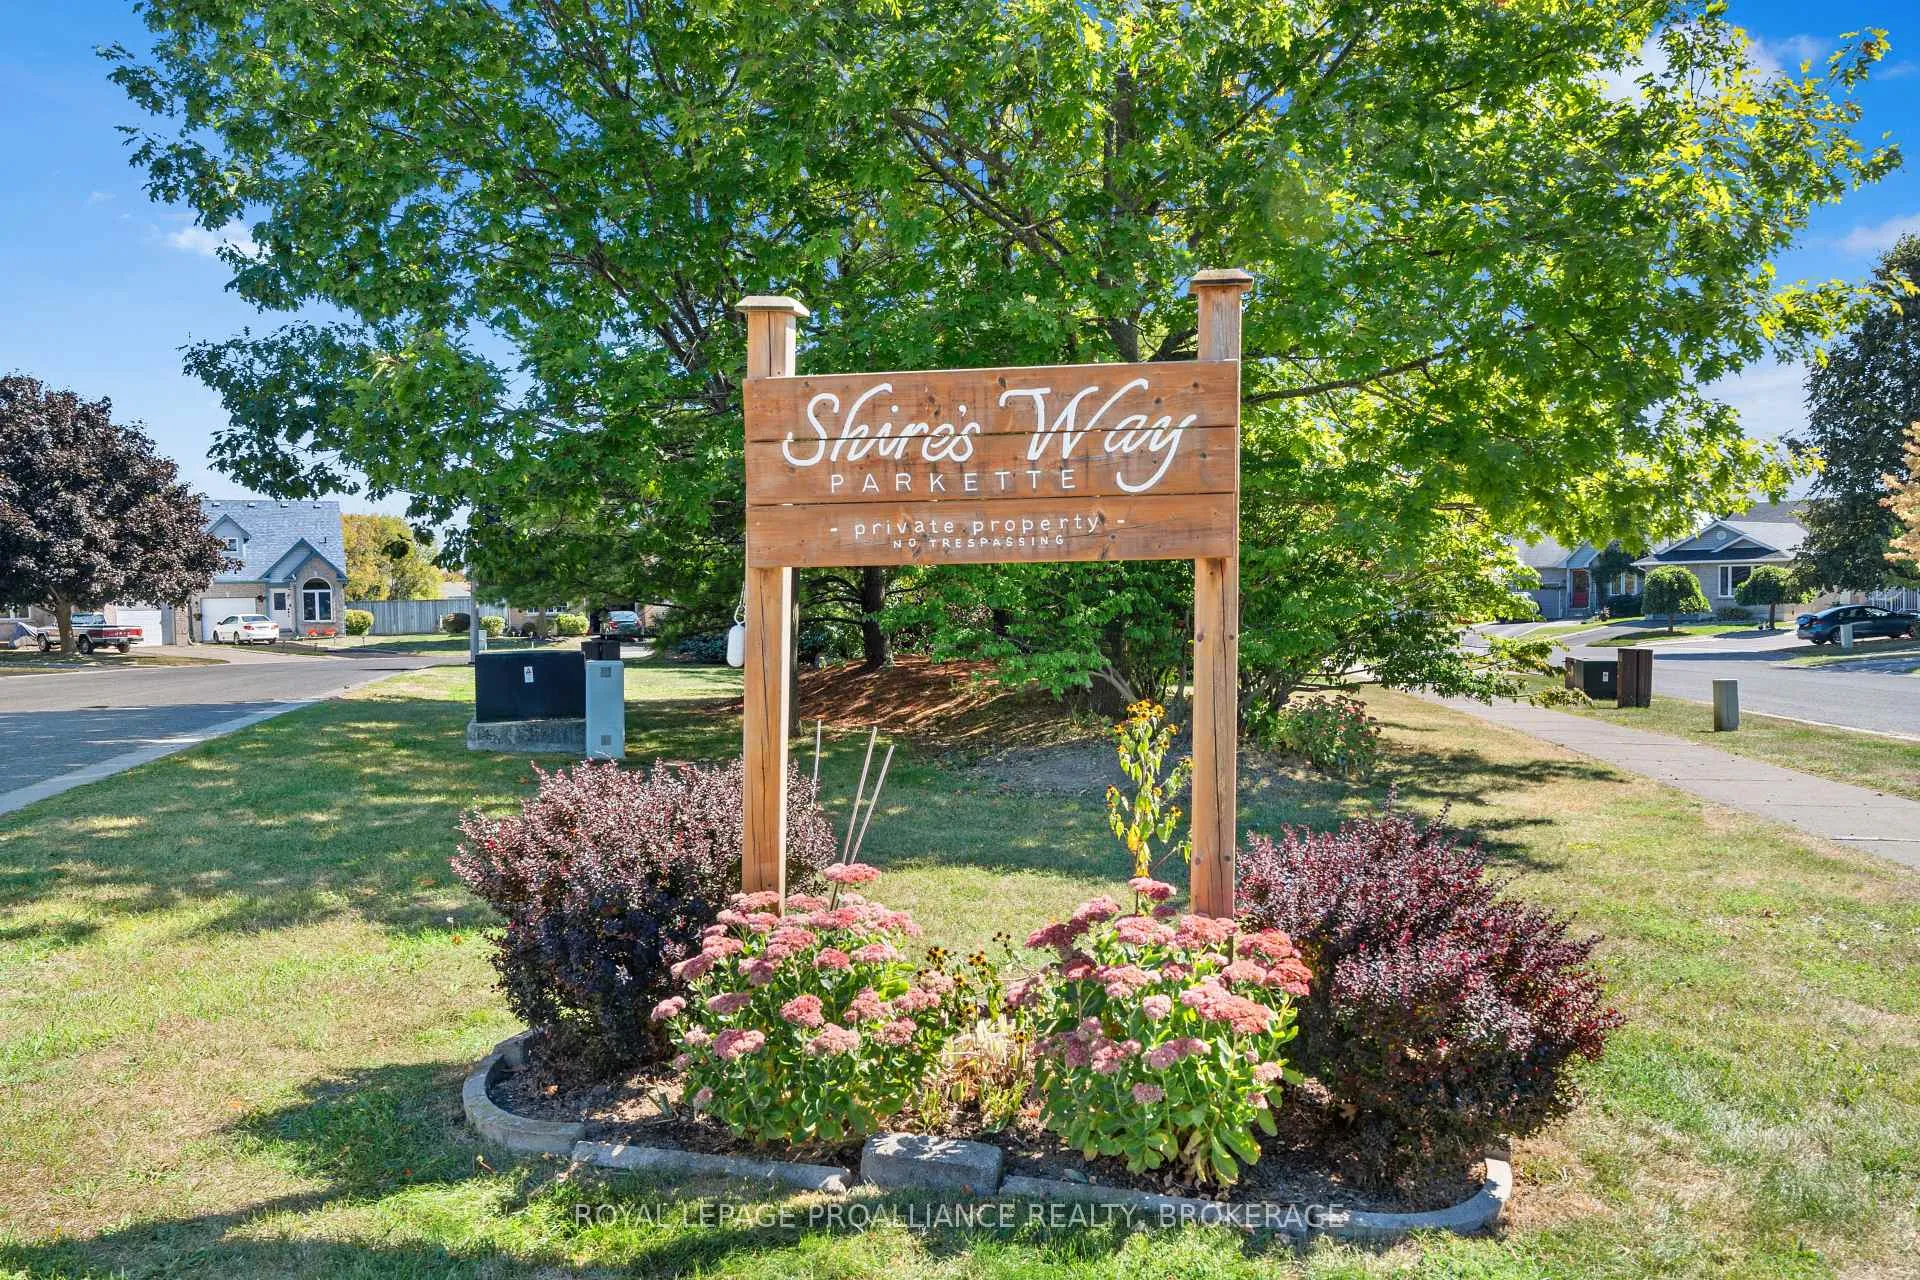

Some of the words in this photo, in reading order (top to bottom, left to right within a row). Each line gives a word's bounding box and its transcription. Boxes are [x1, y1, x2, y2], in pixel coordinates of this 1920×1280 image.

[782, 383, 980, 468] Shire's
[999, 378, 1197, 493] Way
[831, 468, 1075, 493] PARKETTE
[854, 520, 954, 540] private
[973, 513, 1099, 535] property
[893, 538, 917, 549] NO
[928, 534, 1064, 548] TRESPASSING
